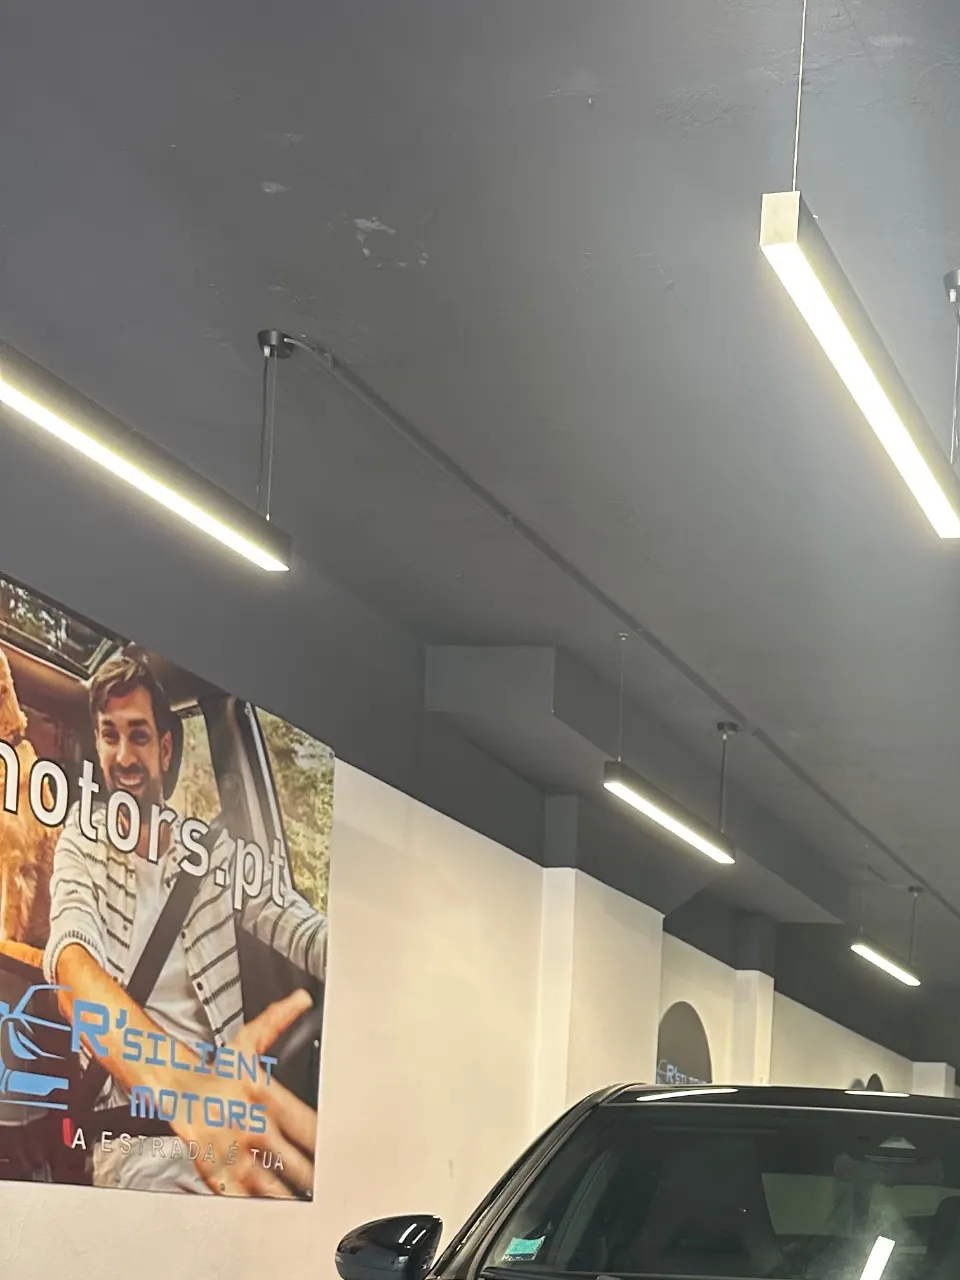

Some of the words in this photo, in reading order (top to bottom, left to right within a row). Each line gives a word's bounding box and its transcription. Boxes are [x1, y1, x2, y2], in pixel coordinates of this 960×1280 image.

[130, 1085, 268, 1134] MOTORS
[71, 1127, 87, 1150] A
[101, 1131, 217, 1165] ESTRADA
[226, 1141, 240, 1165] É
[250, 1148, 285, 1171] TUA
